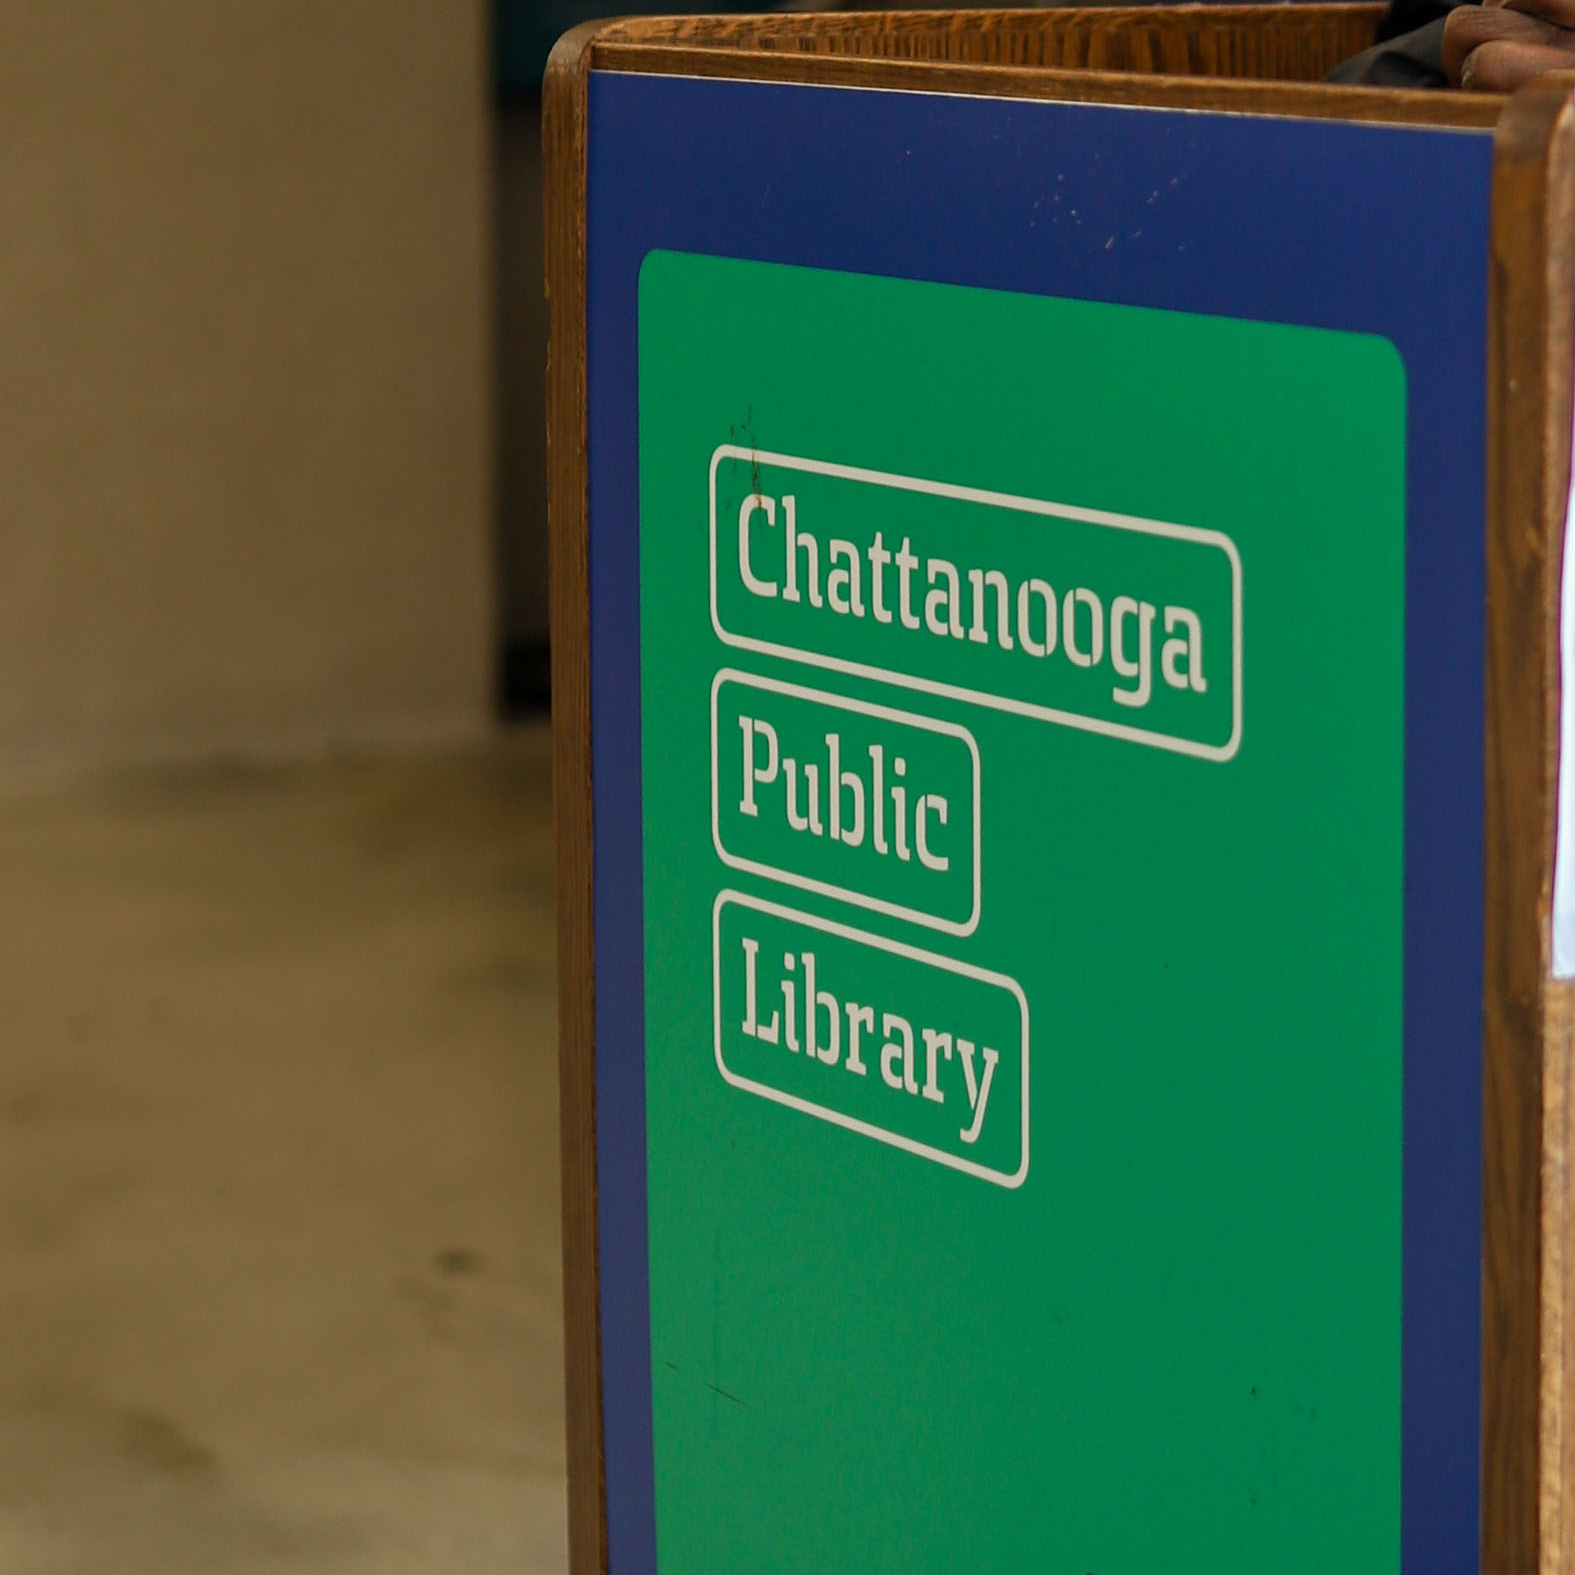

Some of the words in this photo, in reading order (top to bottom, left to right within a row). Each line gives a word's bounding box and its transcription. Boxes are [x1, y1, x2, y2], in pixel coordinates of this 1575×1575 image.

[738, 492, 1207, 708] Chattanooga
[738, 715, 950, 872] Public
[741, 936, 1000, 1145] Library
